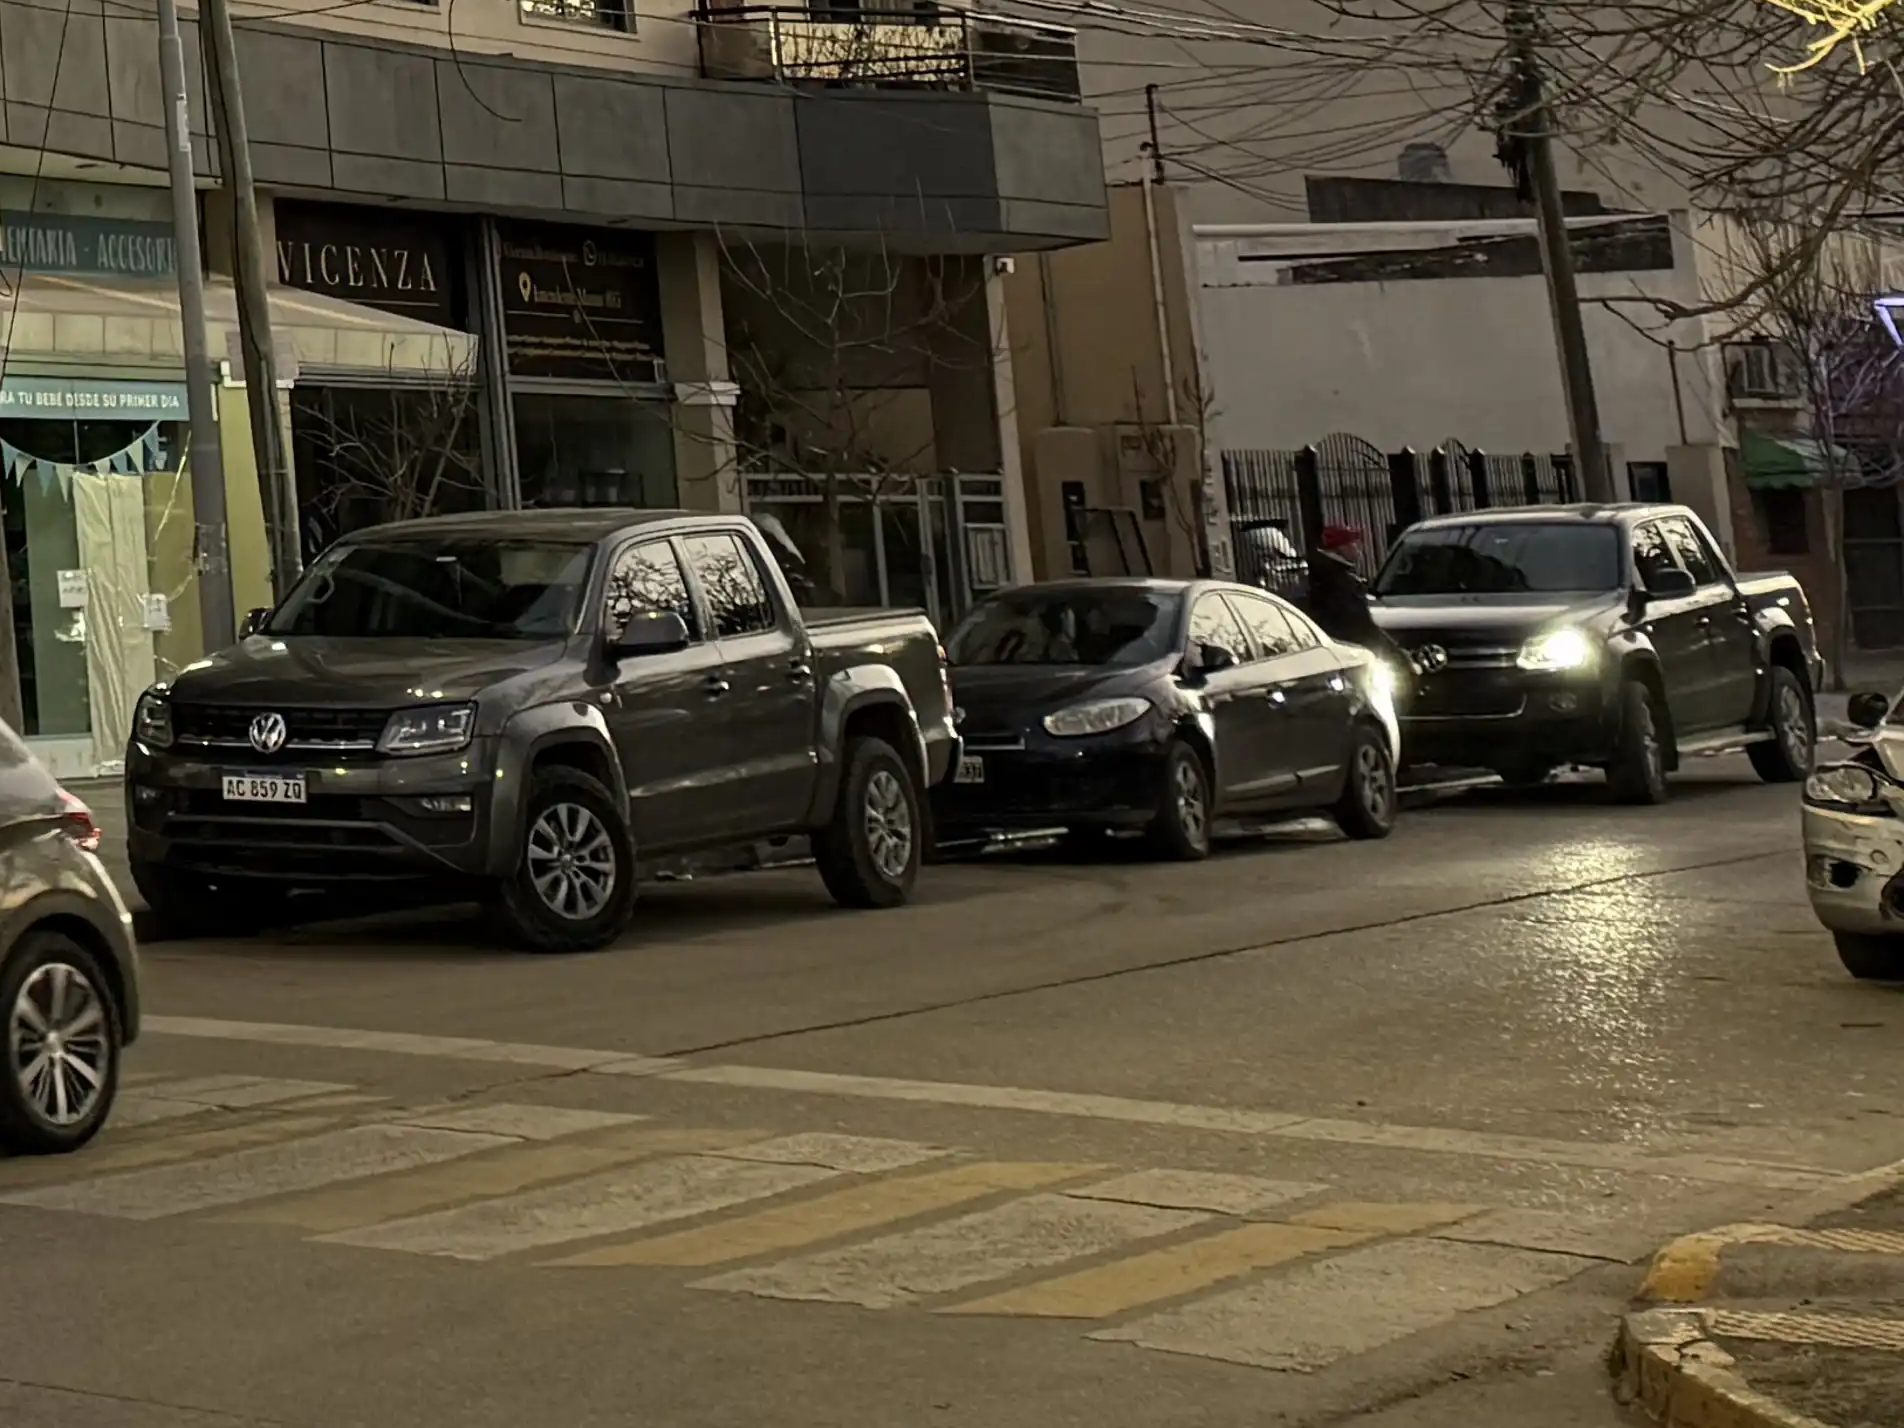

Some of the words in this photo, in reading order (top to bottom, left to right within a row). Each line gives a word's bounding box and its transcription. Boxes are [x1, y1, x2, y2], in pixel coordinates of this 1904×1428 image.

[276, 240, 437, 292] VICENZA
[102, 394, 117, 408] SU
[226, 779, 246, 797] AC
[250, 780, 278, 799] 859
